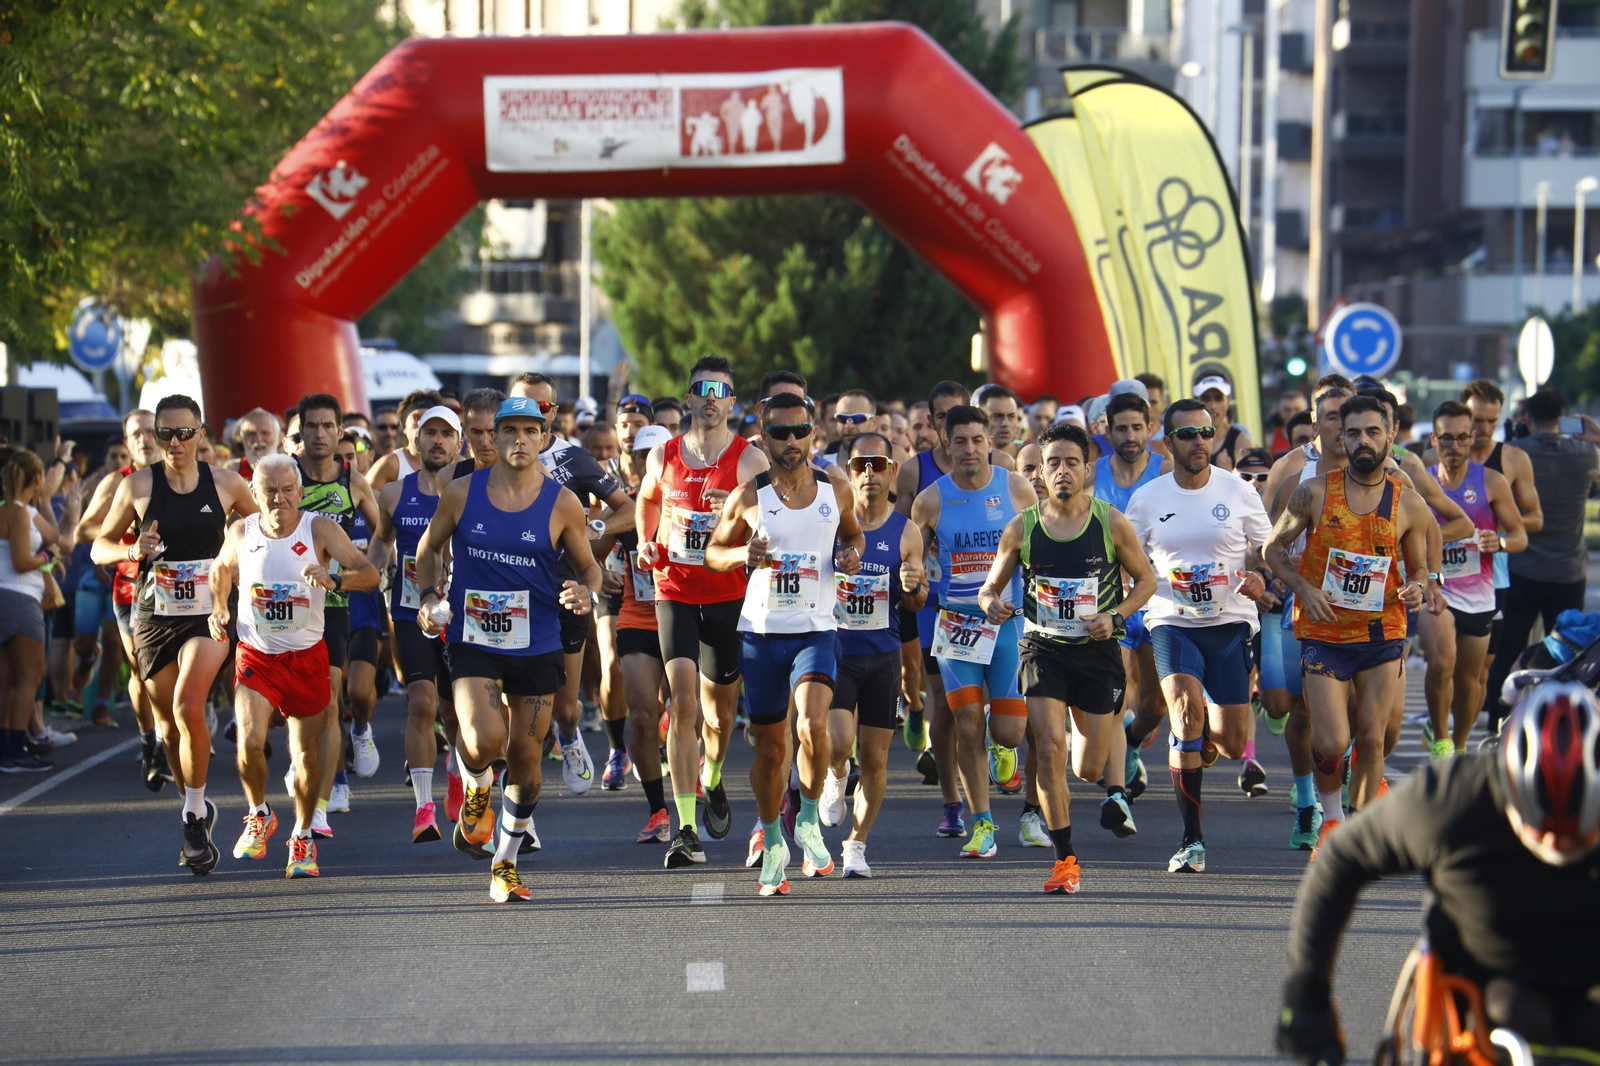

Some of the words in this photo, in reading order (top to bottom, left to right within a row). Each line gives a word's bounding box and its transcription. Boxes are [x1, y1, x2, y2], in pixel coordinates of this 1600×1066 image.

[499, 103, 582, 120] CARRERAS
[585, 102, 673, 119] POPULARES
[684, 530, 711, 550] 187
[467, 546, 536, 568] TROTASIERRA
[956, 552, 997, 562] Maratón
[174, 580, 196, 600] 59
[776, 572, 800, 594] 113
[1190, 582, 1212, 602] 95
[1342, 572, 1371, 594] 130
[266, 601, 293, 620] 391
[846, 595, 874, 615] 318
[1057, 599, 1075, 620] 18
[480, 612, 512, 633] 395
[949, 626, 982, 648] 287
[525, 698, 552, 706] JUANA
